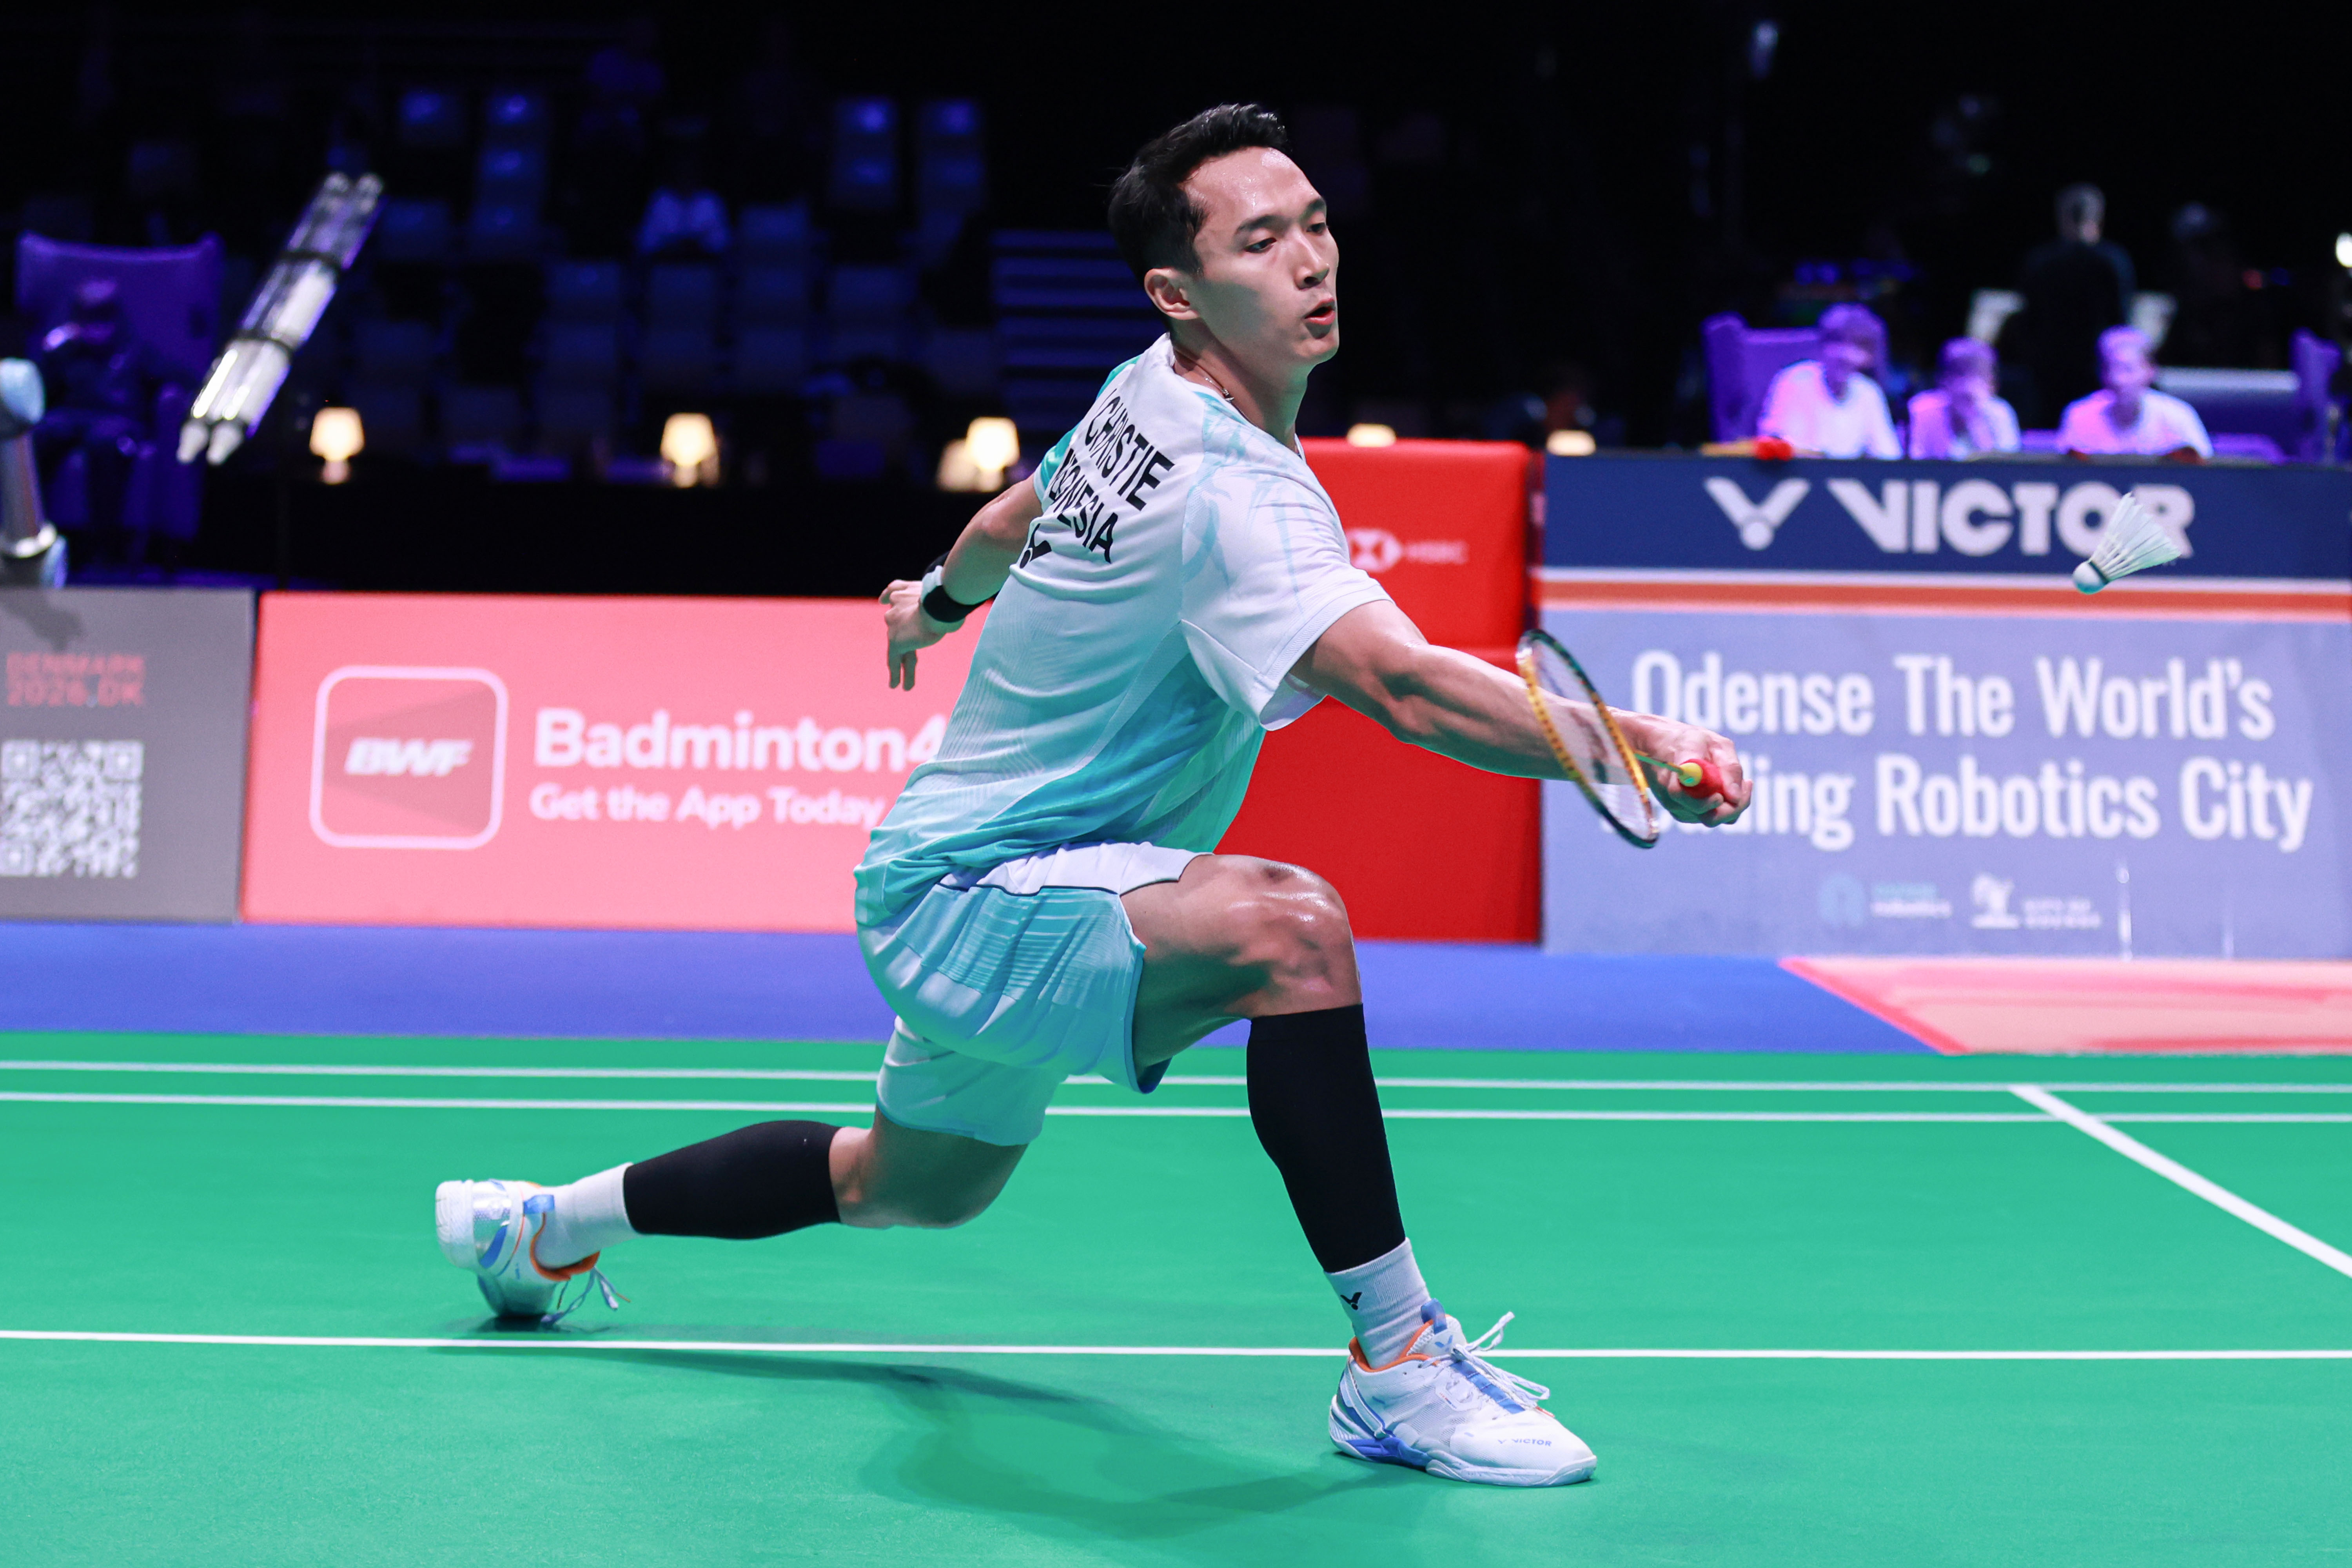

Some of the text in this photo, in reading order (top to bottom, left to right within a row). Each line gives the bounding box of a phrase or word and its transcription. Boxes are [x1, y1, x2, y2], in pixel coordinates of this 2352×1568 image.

[1085, 396, 1175, 511] CHRISTIE
[1828, 477, 2194, 558] VICTOR
[1633, 649, 1874, 735] Odense
[1893, 655, 2015, 737] The
[345, 738, 473, 777] BWF
[529, 782, 887, 832] Get the App Today
[1876, 753, 2160, 840] Robotics
[2180, 757, 2314, 853] City
